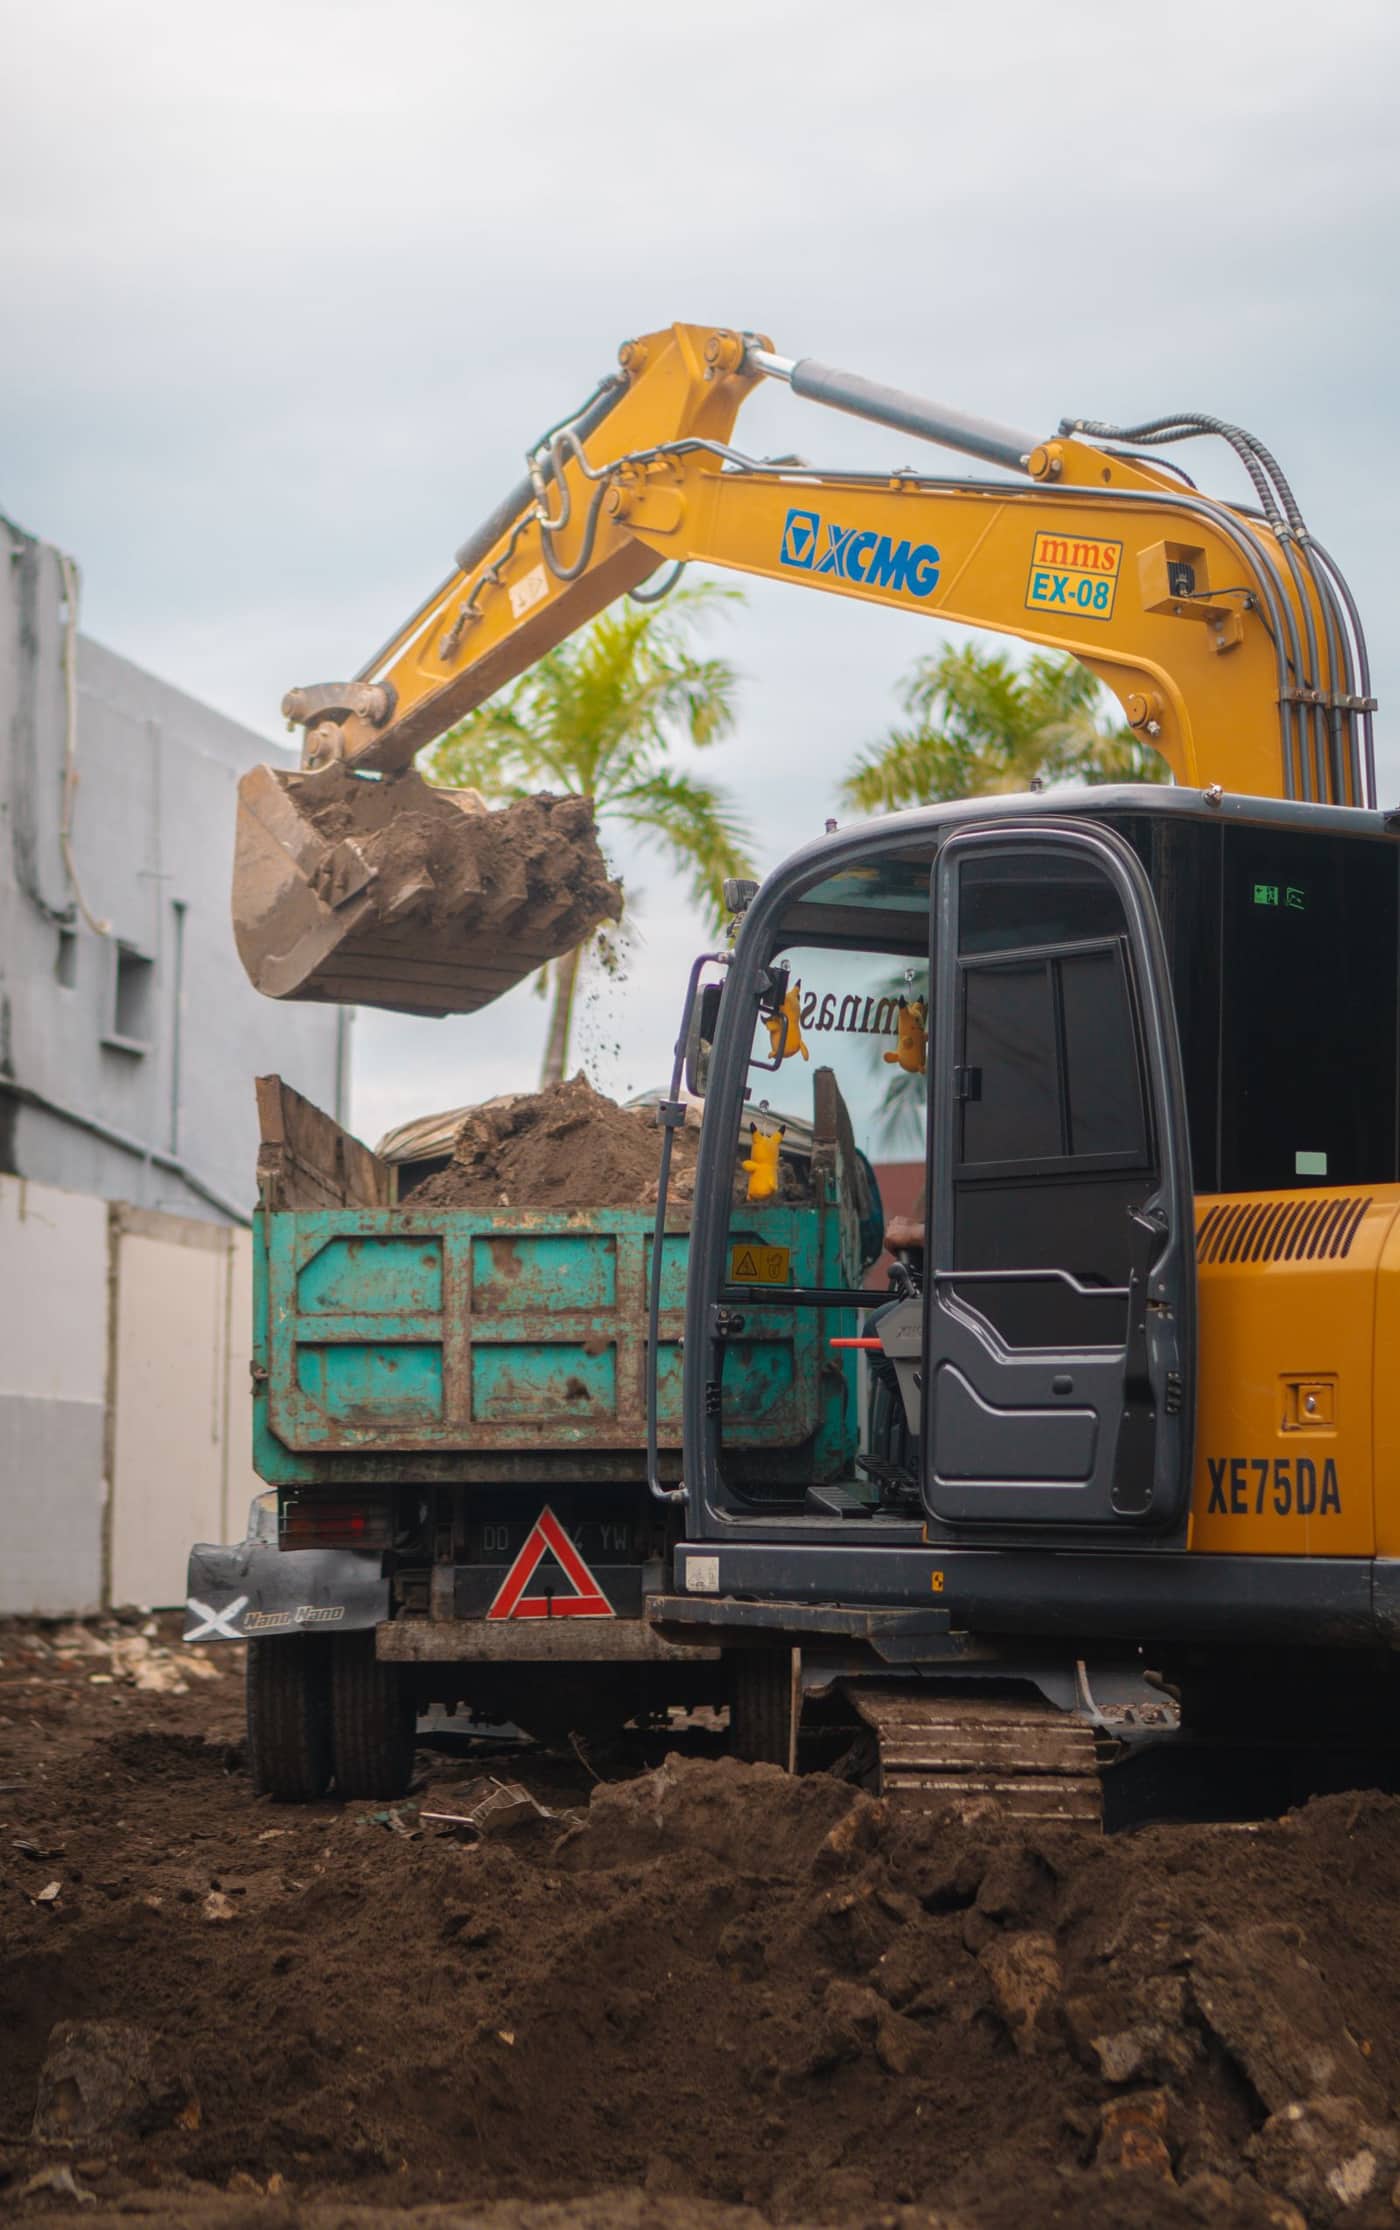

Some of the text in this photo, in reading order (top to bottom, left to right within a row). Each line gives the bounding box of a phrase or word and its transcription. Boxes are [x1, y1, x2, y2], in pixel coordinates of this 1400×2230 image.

[814, 524, 941, 598] XCMG
[1039, 539, 1116, 571] mms
[1032, 572, 1110, 610] EX-08
[1207, 1458, 1342, 1516] XE75DA
[295, 1605, 345, 1623] Nano
